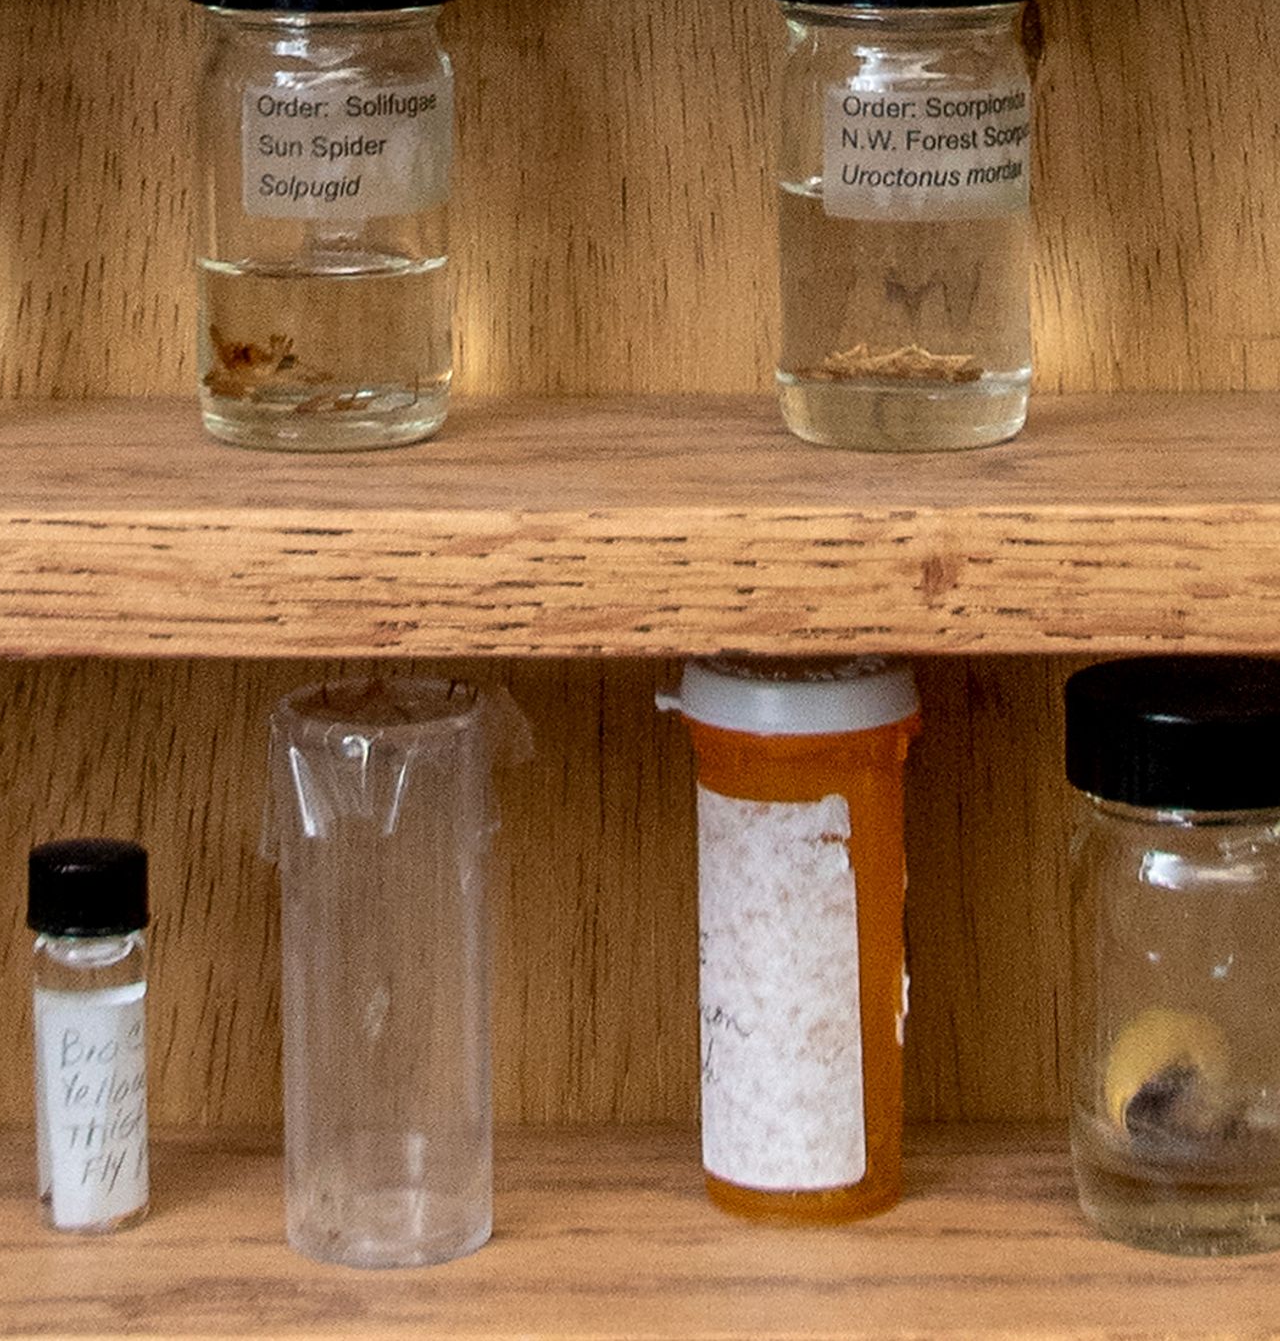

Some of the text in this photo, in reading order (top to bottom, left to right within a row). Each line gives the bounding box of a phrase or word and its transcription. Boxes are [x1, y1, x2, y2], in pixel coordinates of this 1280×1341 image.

[257, 94, 330, 118] Order:
[843, 95, 917, 119] Order:
[258, 134, 387, 162] Sun Spider
[906, 129, 978, 152] Forest
[258, 173, 363, 202] Solpugid
[842, 163, 961, 189] Uroctonus
